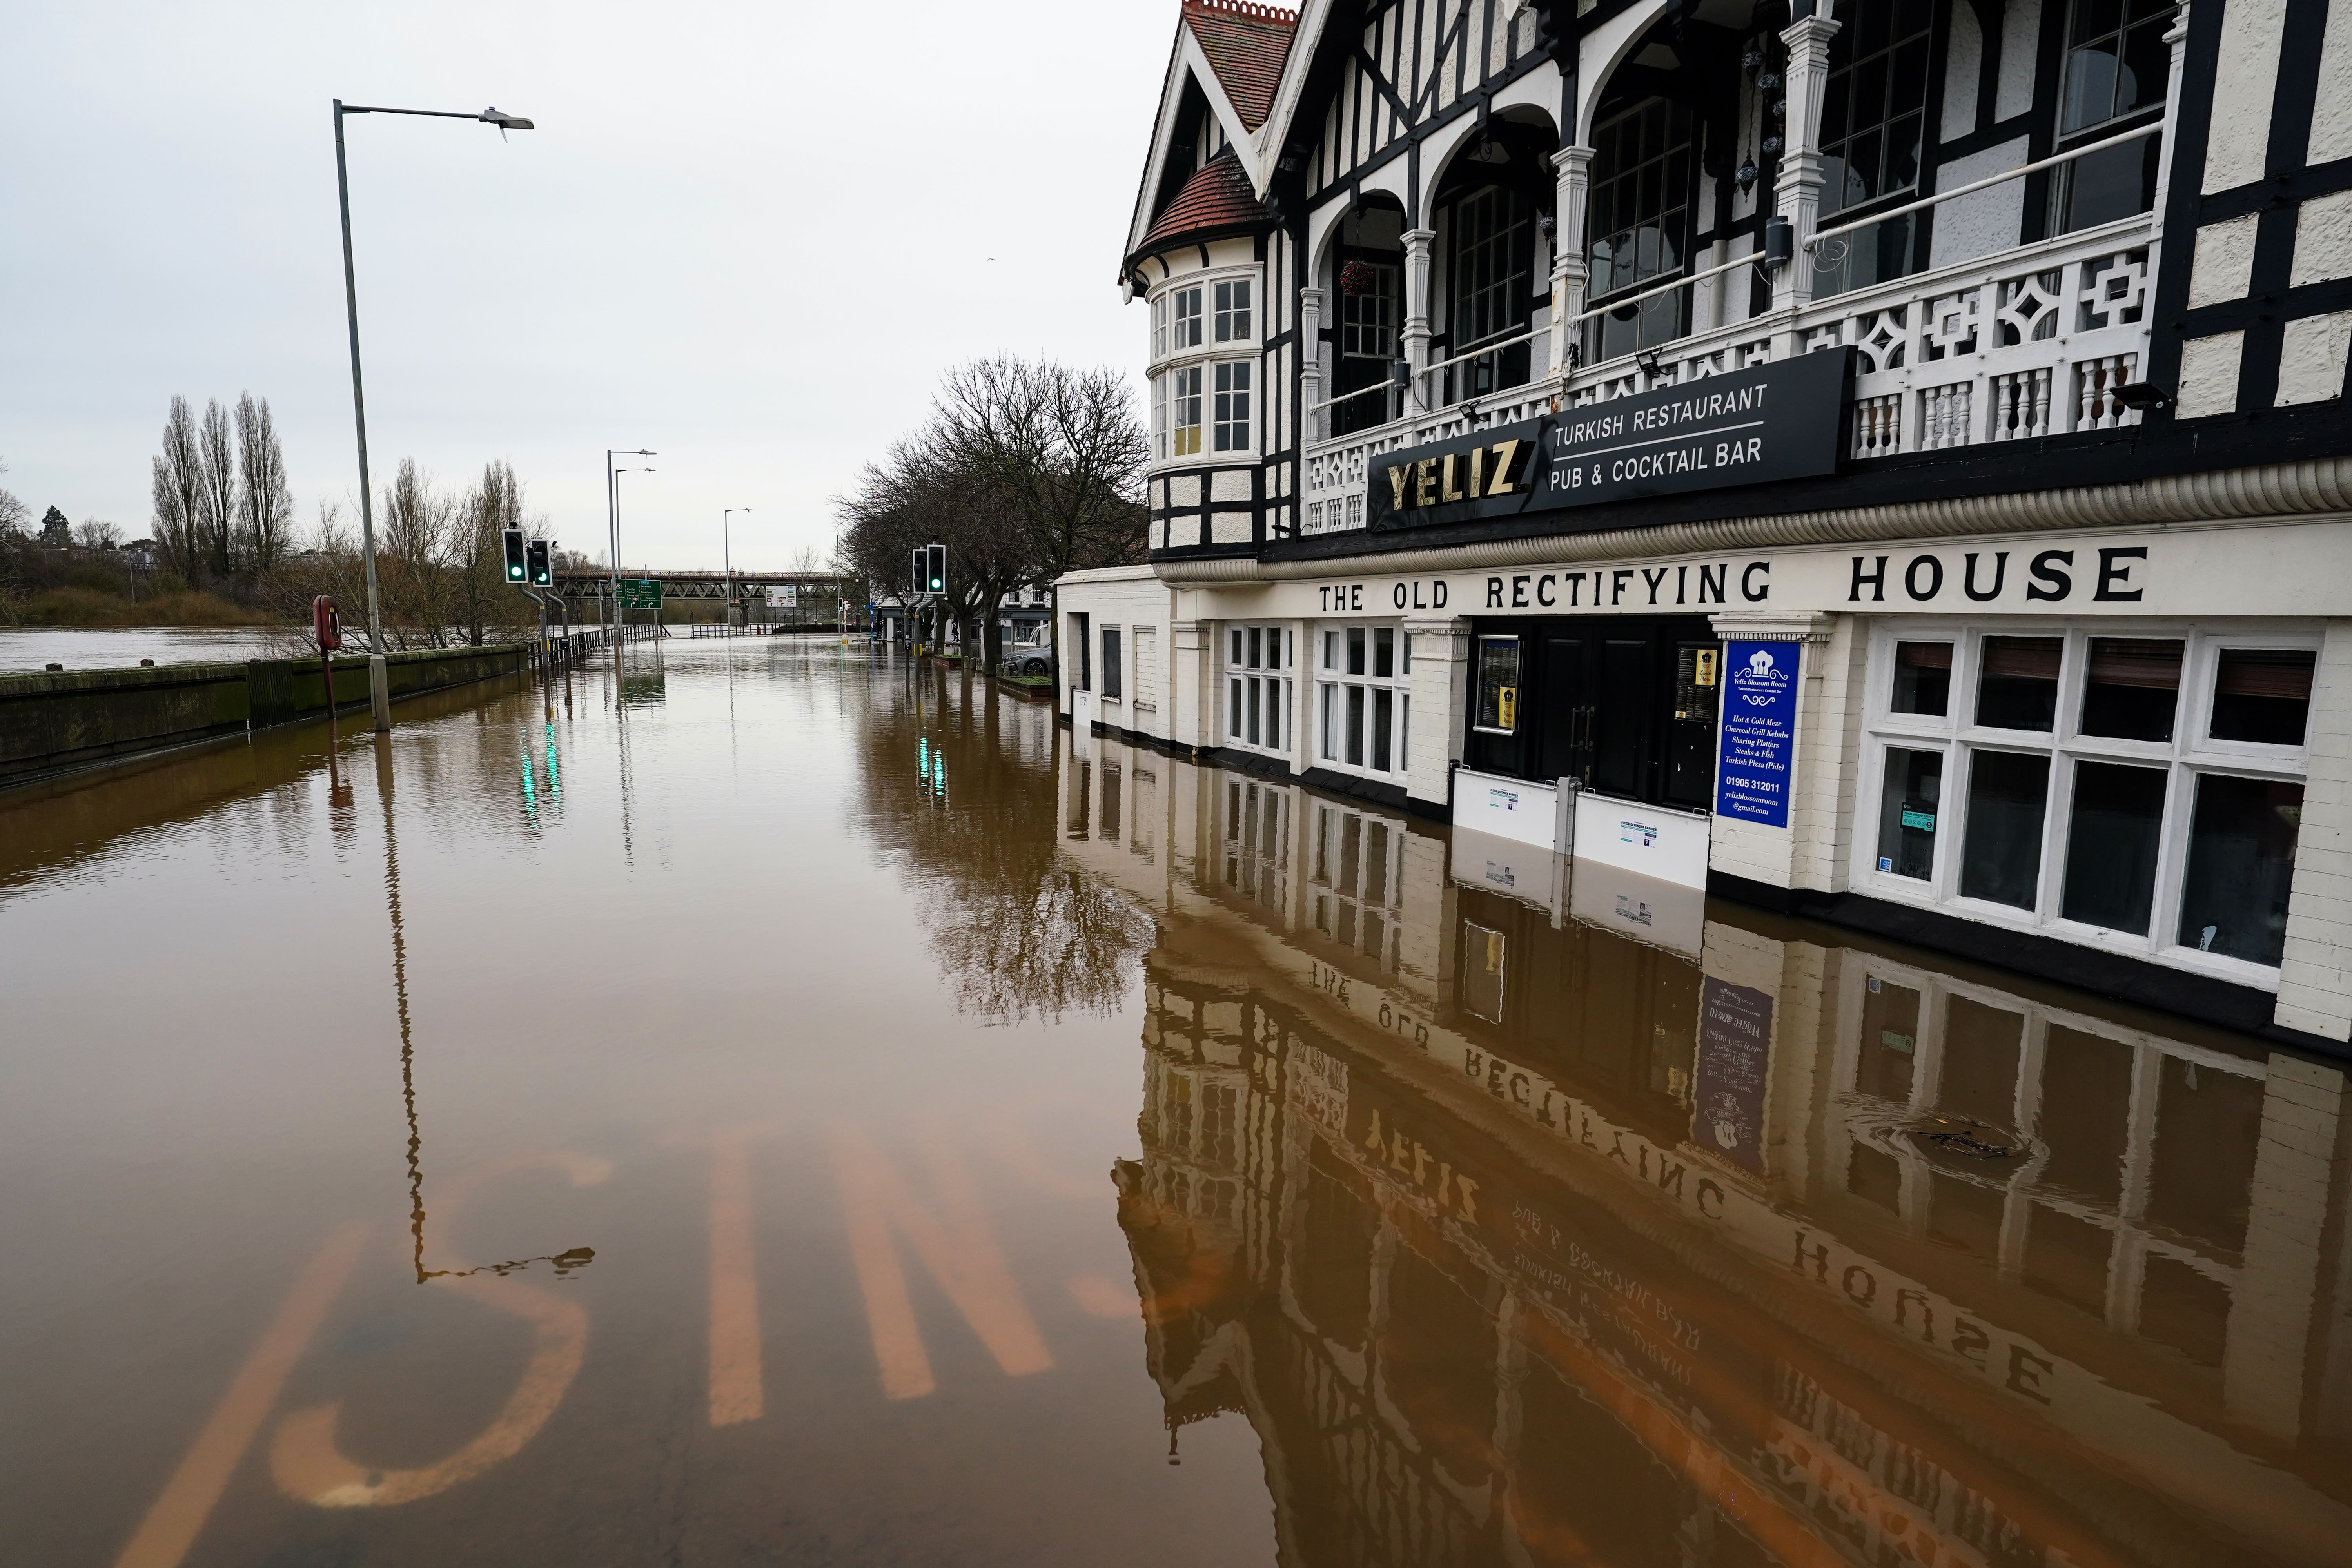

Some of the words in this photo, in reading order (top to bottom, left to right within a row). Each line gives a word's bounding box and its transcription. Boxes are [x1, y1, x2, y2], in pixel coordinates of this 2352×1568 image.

[1555, 414, 1623, 446] TURKISH
[1633, 384, 1767, 430] RESTAURANT
[1550, 467, 1582, 491] PUB
[1592, 464, 1602, 485] &
[1613, 447, 1708, 482] COCKTAIL
[1715, 437, 1762, 467] BAR
[1388, 439, 1523, 511] YELIZ
[1319, 584, 1363, 612] THE
[1394, 580, 1448, 609] OLD
[1486, 561, 1770, 608] RECTIFYING
[1848, 546, 2148, 602] HOUSE
[1751, 717, 1765, 725] Cold
[1766, 719, 1782, 727] Meze
[1725, 725, 1751, 734] Charcoal
[1751, 728, 1766, 736] Grill
[1766, 729, 1789, 739] Kebabs
[1732, 736, 1755, 747] Sharing
[1756, 739, 1780, 748] Platters
[1735, 747, 1754, 756] Steaks
[1761, 750, 1774, 759] Fish
[1725, 756, 1747, 766] Turkish
[1748, 759, 1764, 768] Pizza
[1766, 762, 1784, 772] (Pide)
[1726, 776, 1749, 788] 01905
[1751, 780, 1779, 793] 312011
[1725, 791, 1778, 806] yelizblossomroom
[1733, 802, 1769, 815] @gmail.com
